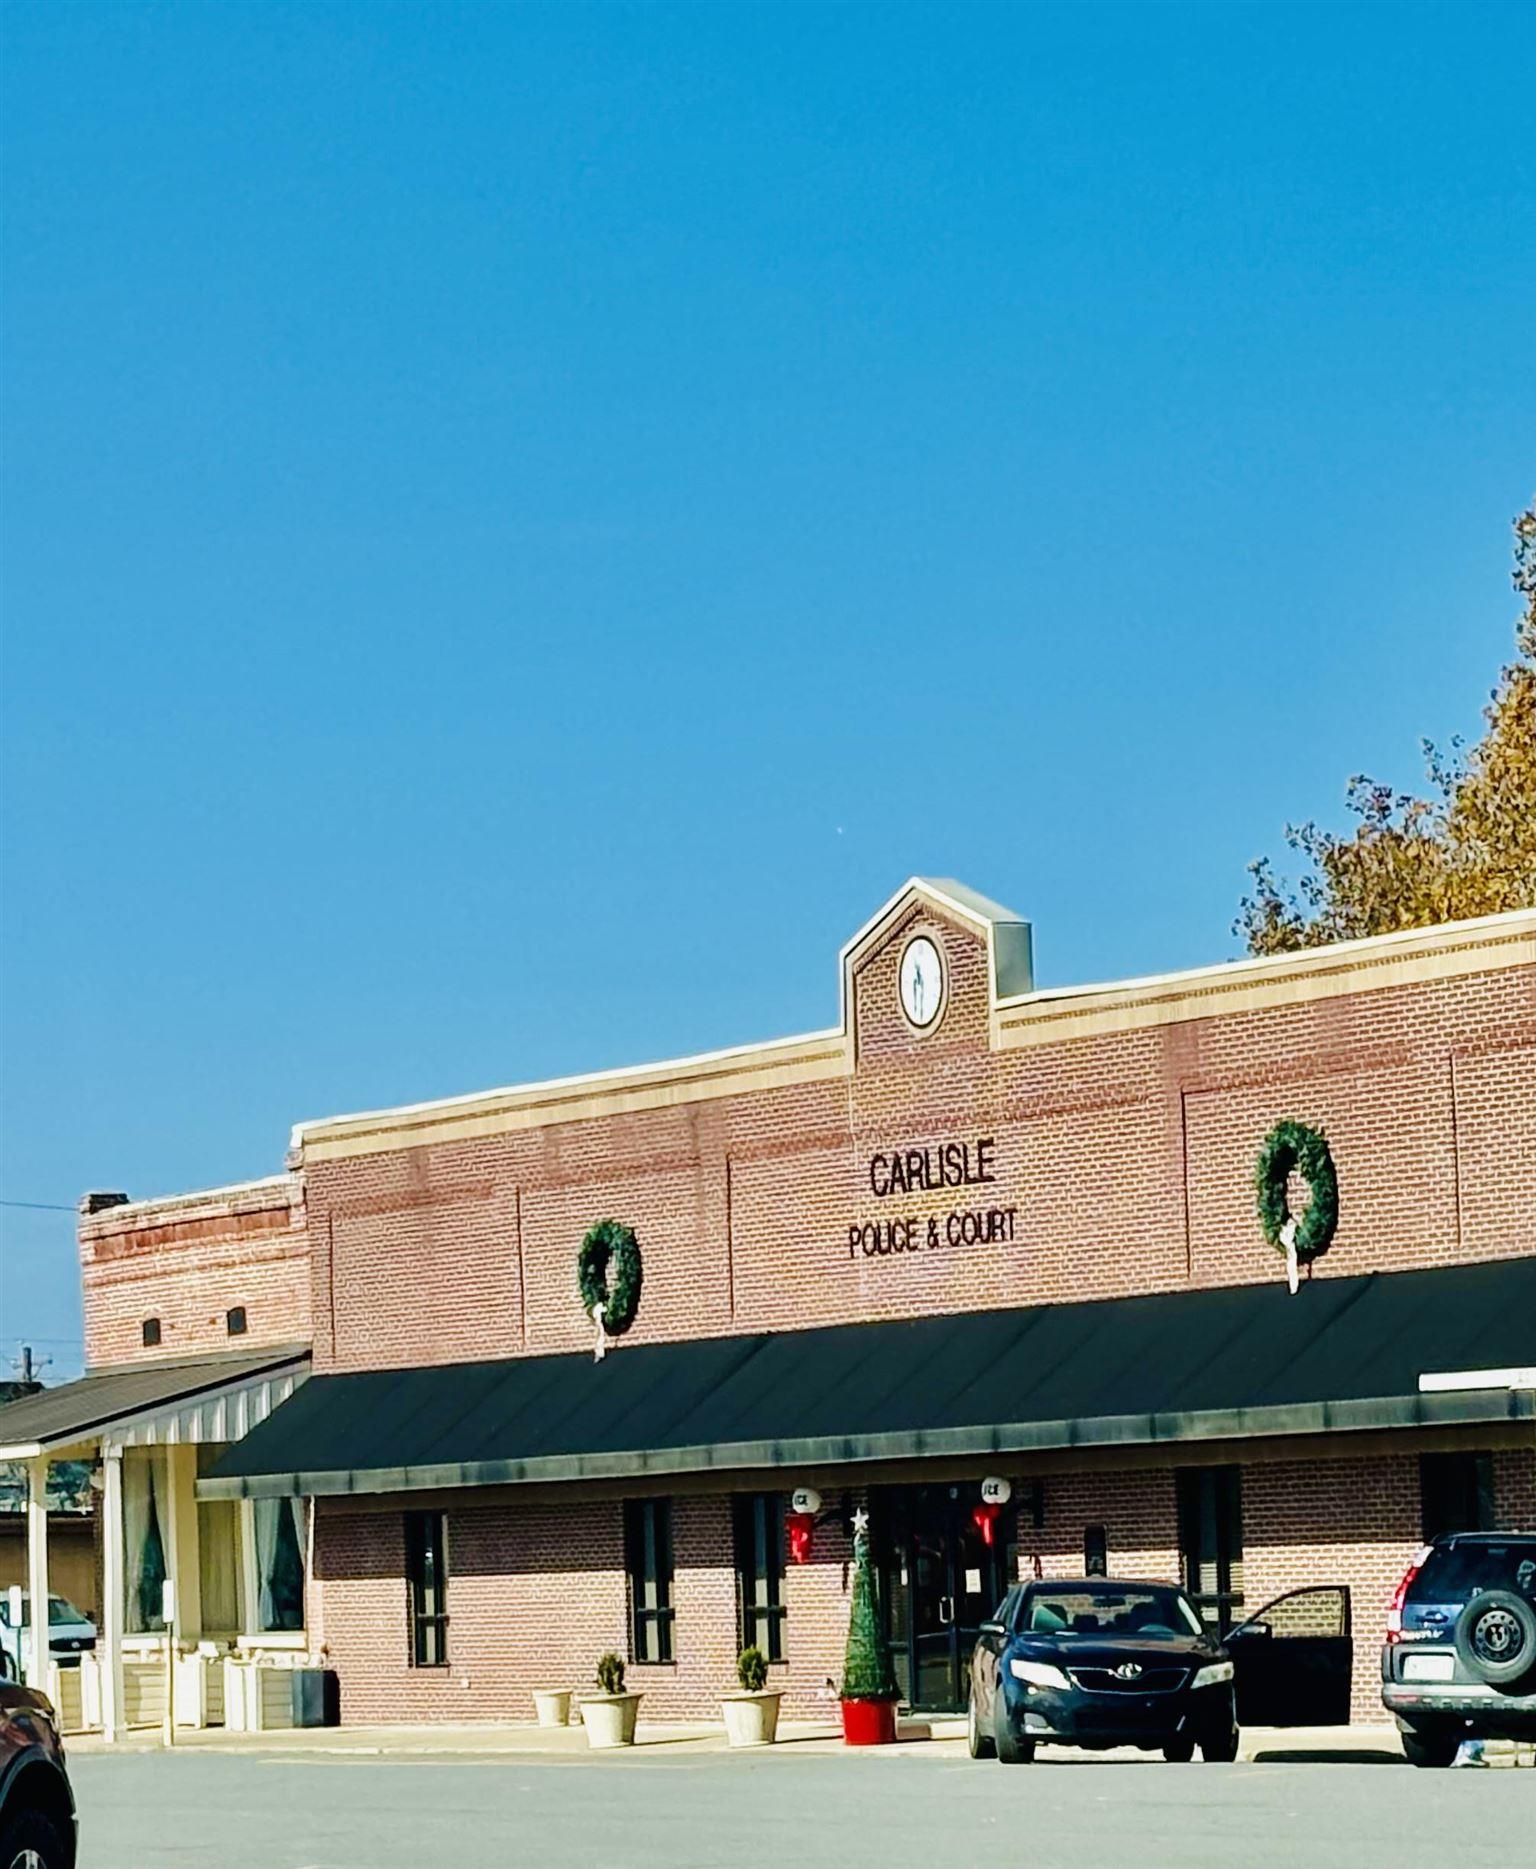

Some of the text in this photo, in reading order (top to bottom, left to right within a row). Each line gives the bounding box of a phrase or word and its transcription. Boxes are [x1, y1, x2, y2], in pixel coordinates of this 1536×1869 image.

[870, 1137, 996, 1197] CARLISLE
[849, 1207, 1018, 1258] POLICE & COURT
